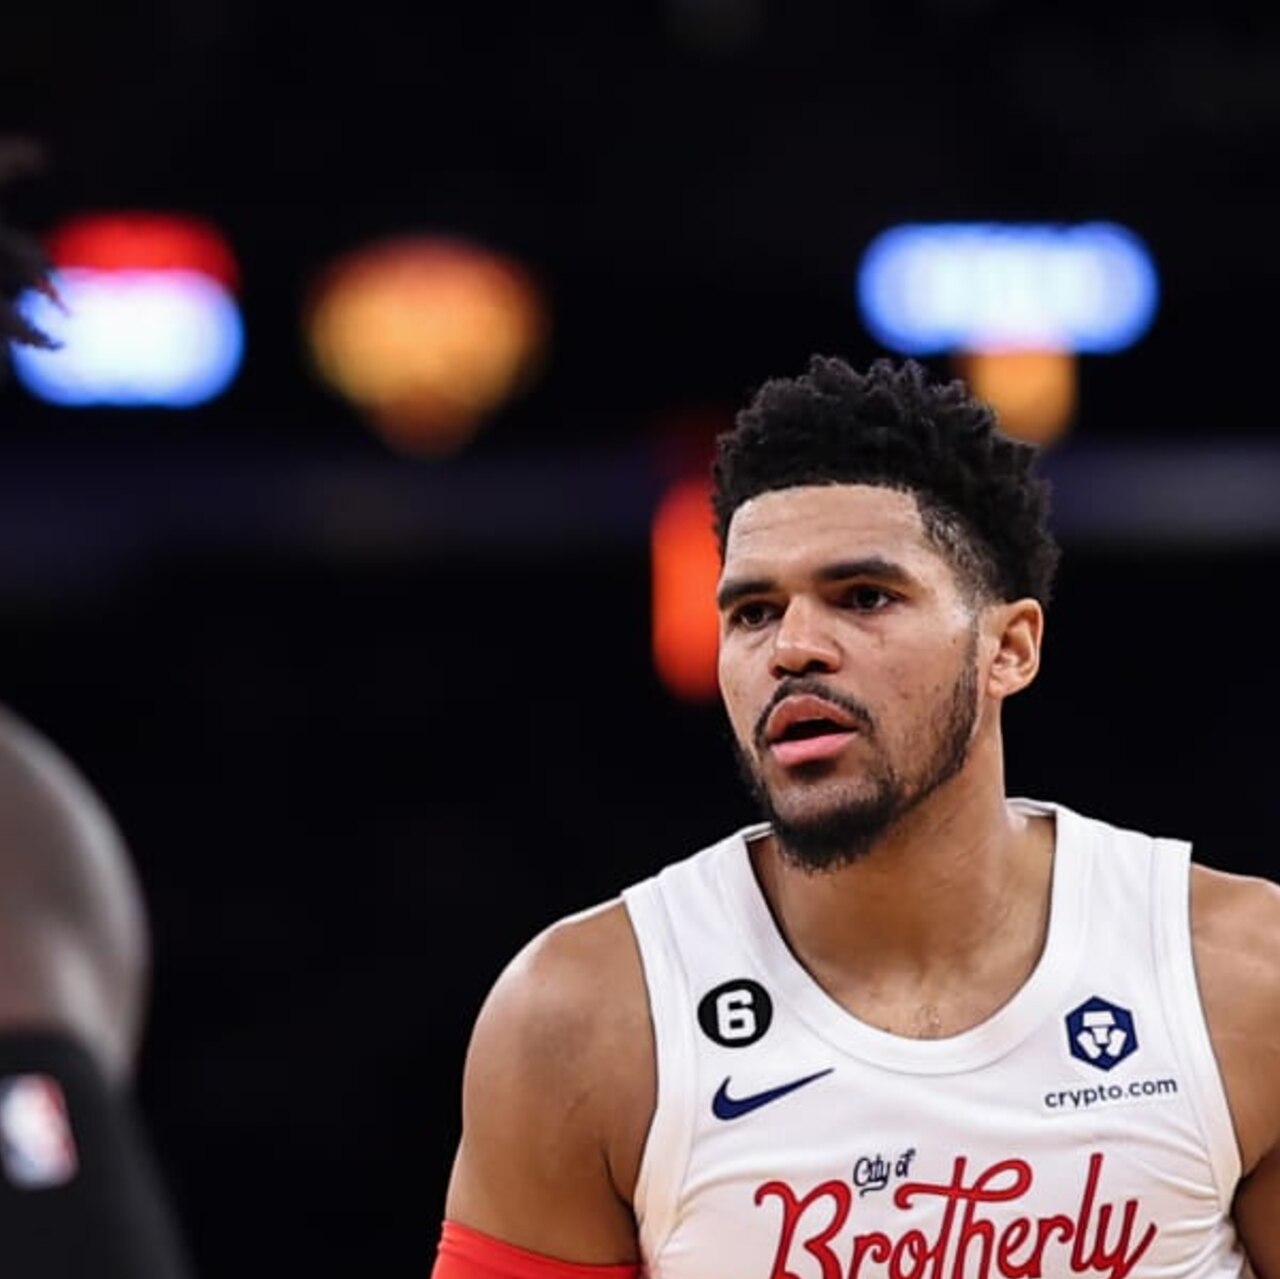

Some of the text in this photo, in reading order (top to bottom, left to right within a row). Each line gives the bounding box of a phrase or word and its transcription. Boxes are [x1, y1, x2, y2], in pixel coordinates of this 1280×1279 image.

[716, 989, 757, 1040] 6
[1043, 1077, 1178, 1109] crypto.com
[853, 1147, 916, 1198] City of
